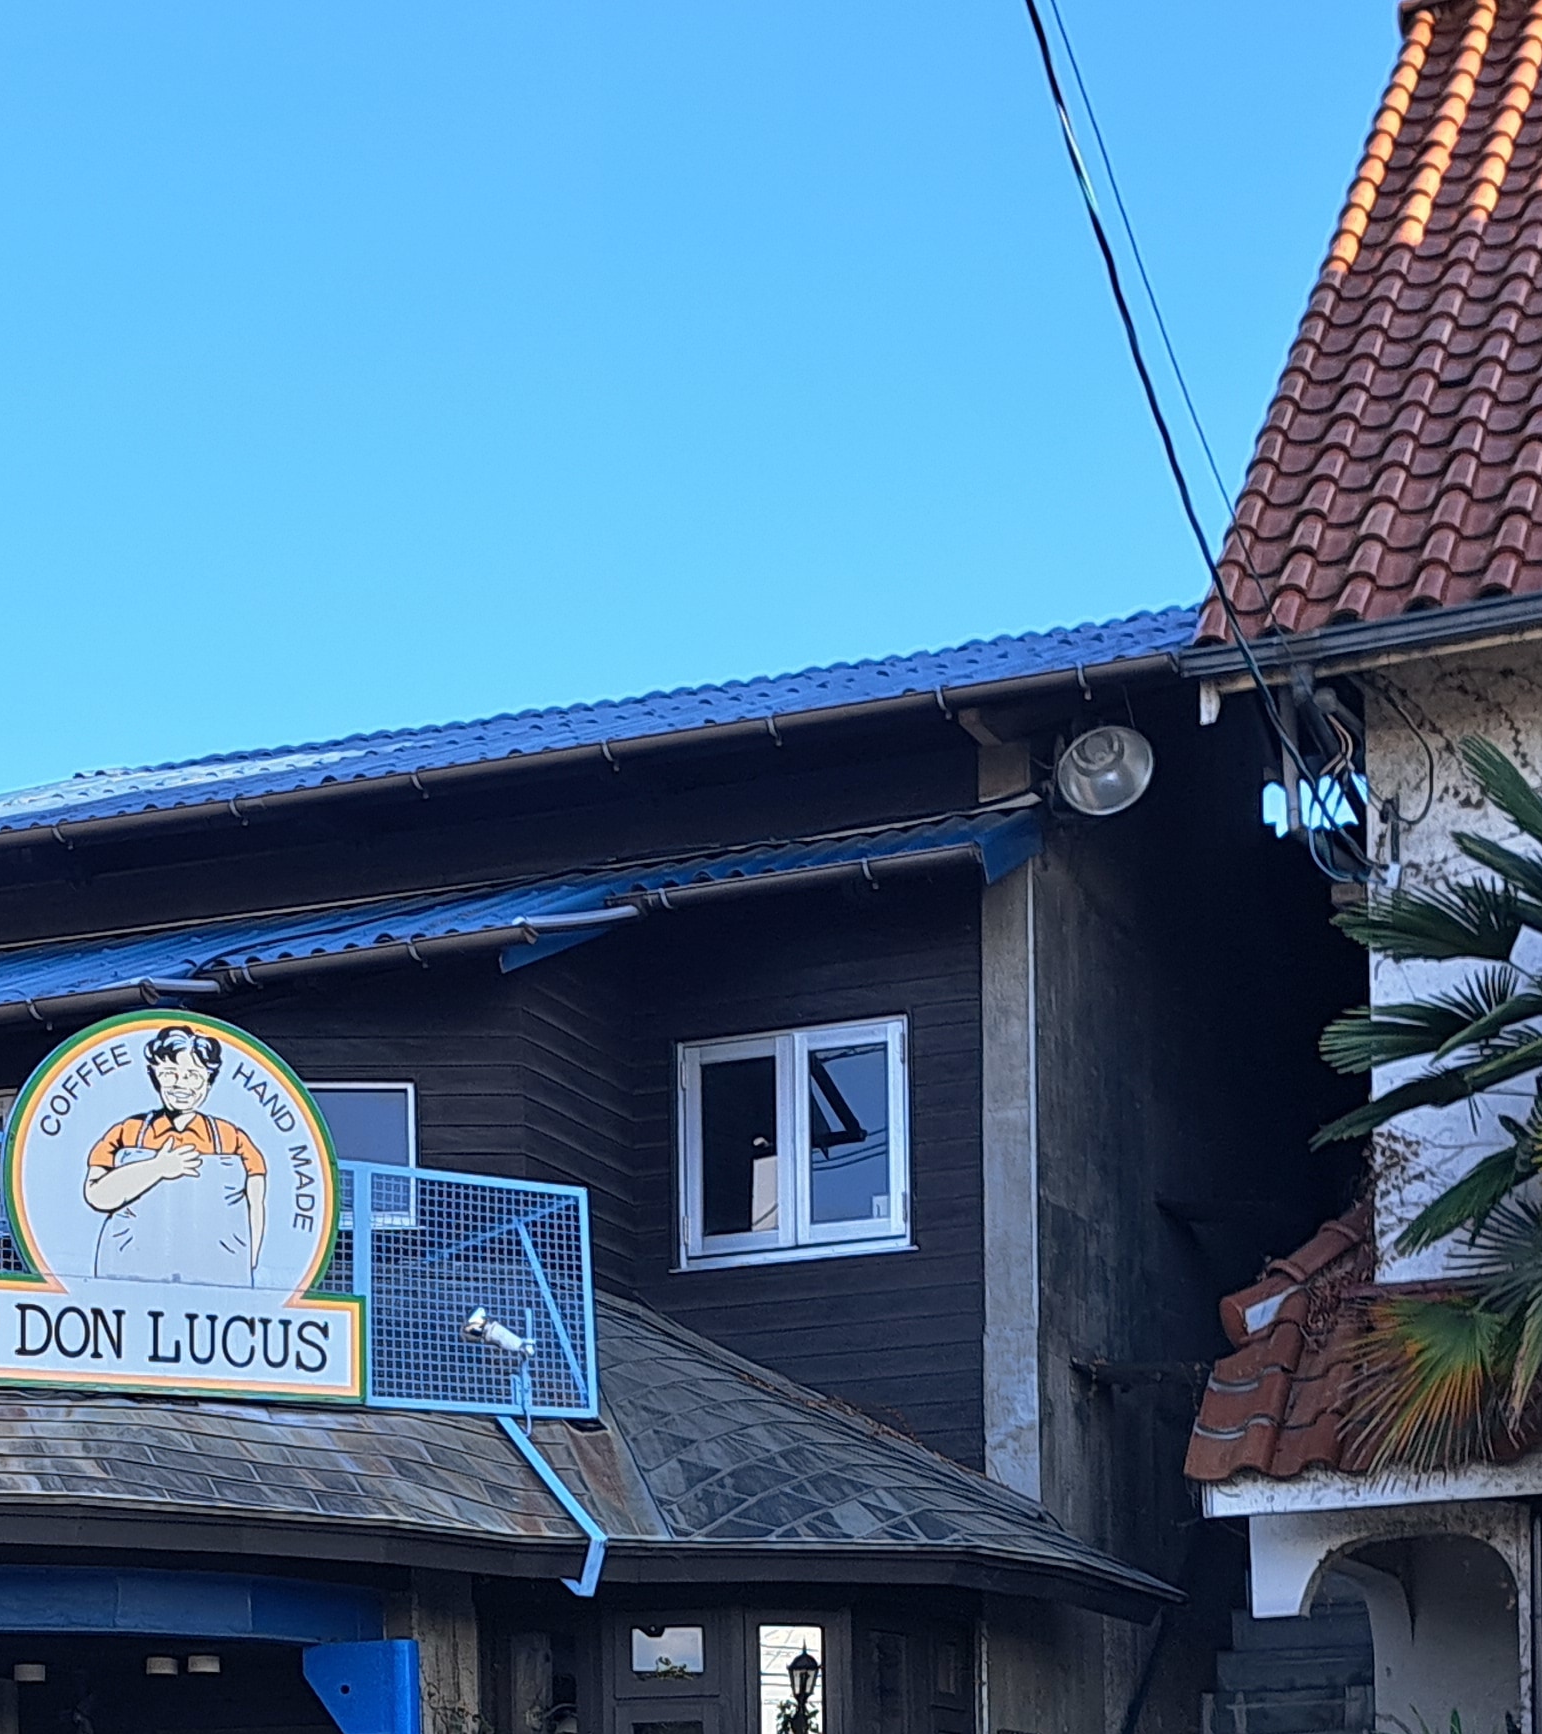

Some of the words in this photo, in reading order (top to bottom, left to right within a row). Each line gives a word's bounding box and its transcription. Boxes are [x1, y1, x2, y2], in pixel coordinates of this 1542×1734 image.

[40, 1043, 132, 1137] COFFEE
[232, 1062, 296, 1133] HAND
[288, 1144, 316, 1233] MADE
[14, 1303, 126, 1359] DON
[147, 1310, 330, 1373] LUCUS
